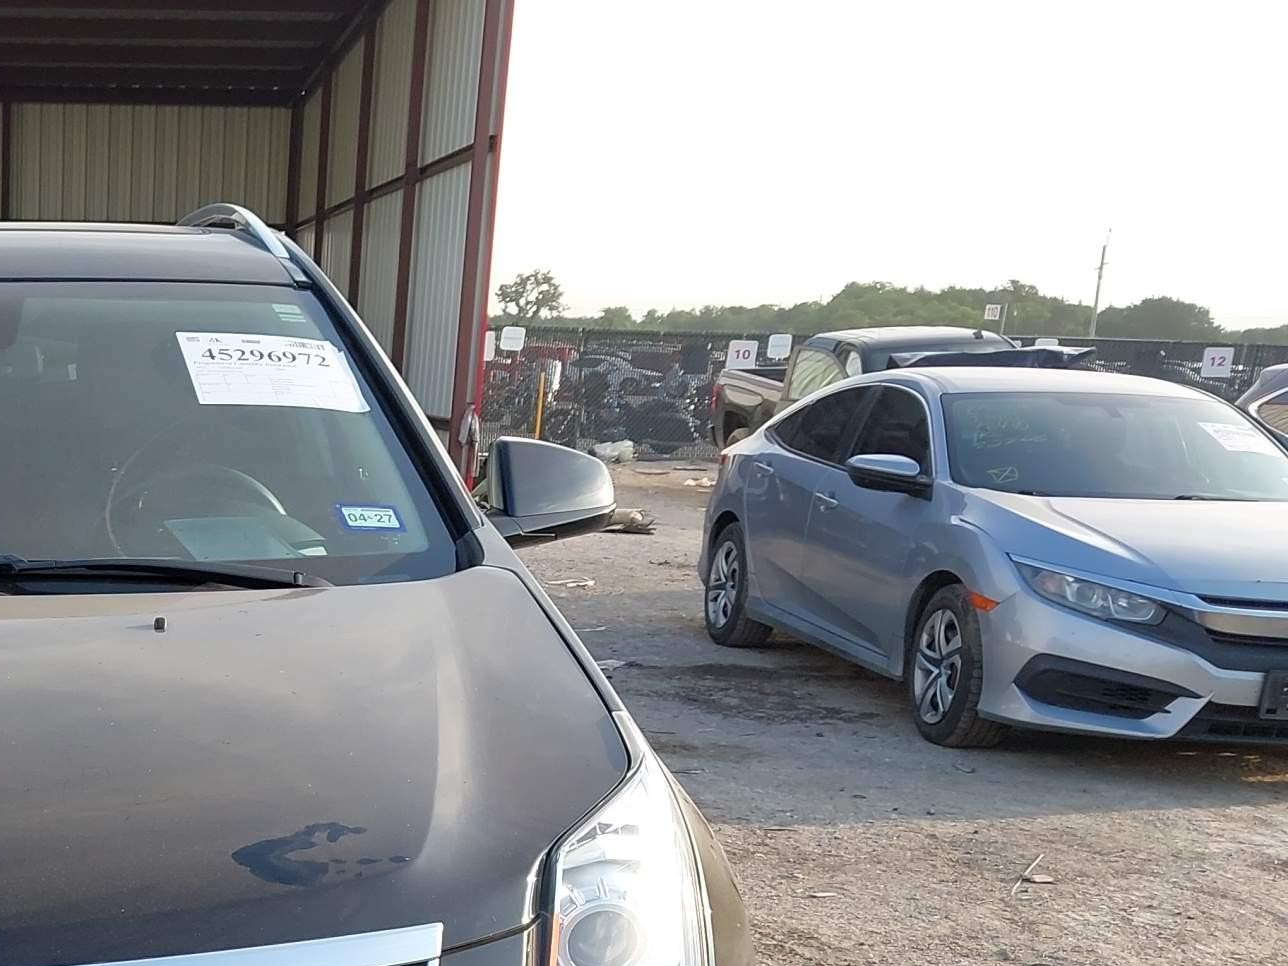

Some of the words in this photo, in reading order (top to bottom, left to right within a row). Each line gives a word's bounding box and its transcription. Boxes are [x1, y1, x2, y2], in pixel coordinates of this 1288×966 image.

[202, 348, 330, 368] 45296972
[735, 349, 751, 360] 10
[1210, 356, 1226, 367] 12
